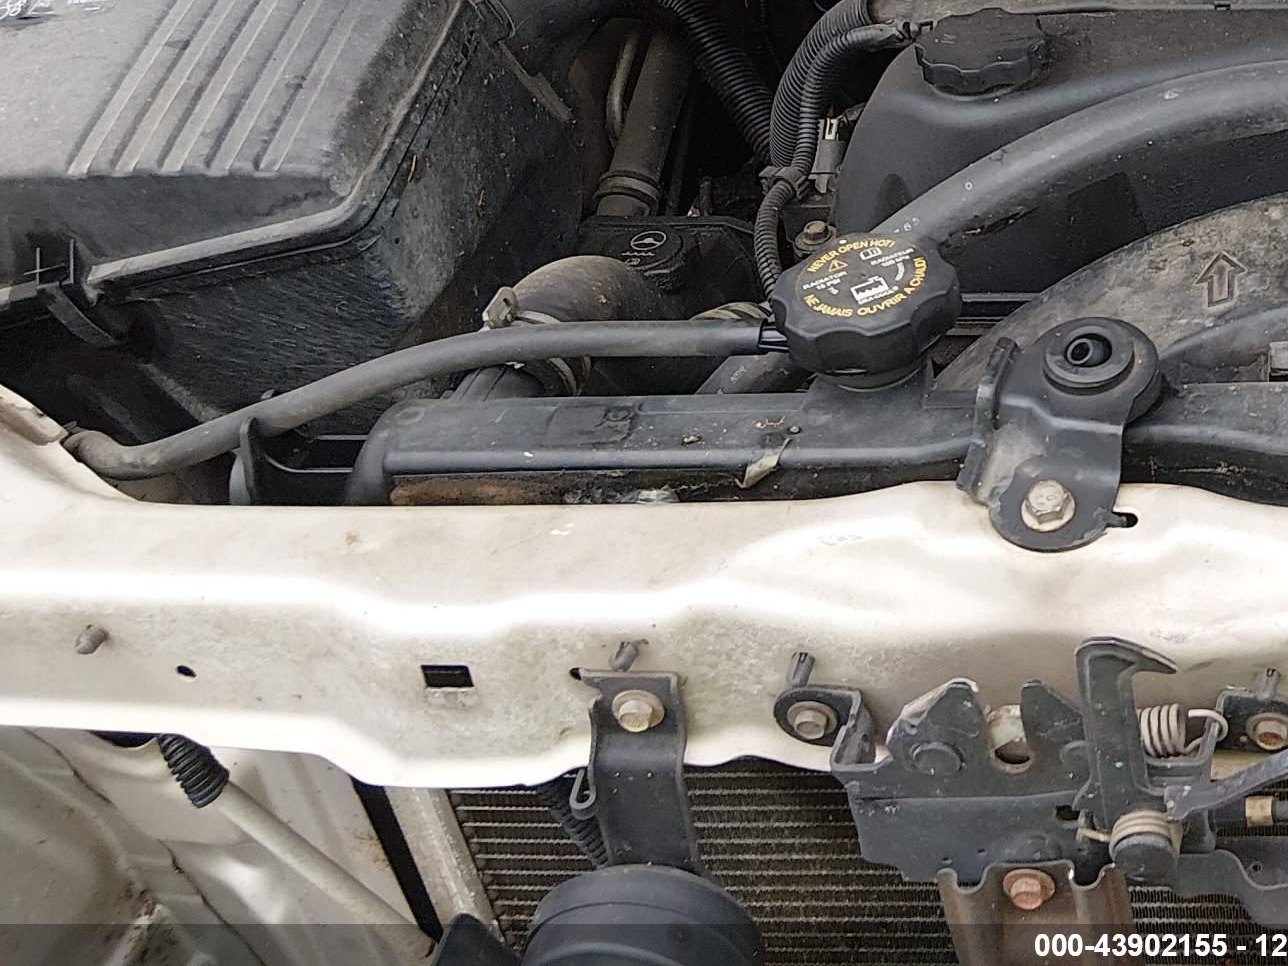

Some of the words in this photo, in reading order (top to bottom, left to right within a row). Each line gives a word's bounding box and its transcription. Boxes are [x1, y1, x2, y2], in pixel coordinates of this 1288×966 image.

[807, 249, 840, 272] NEVER
[839, 241, 869, 255] OPEN
[803, 293, 818, 308] NE
[813, 301, 853, 318] JAMAIS
[857, 292, 907, 316] OUVRIR
